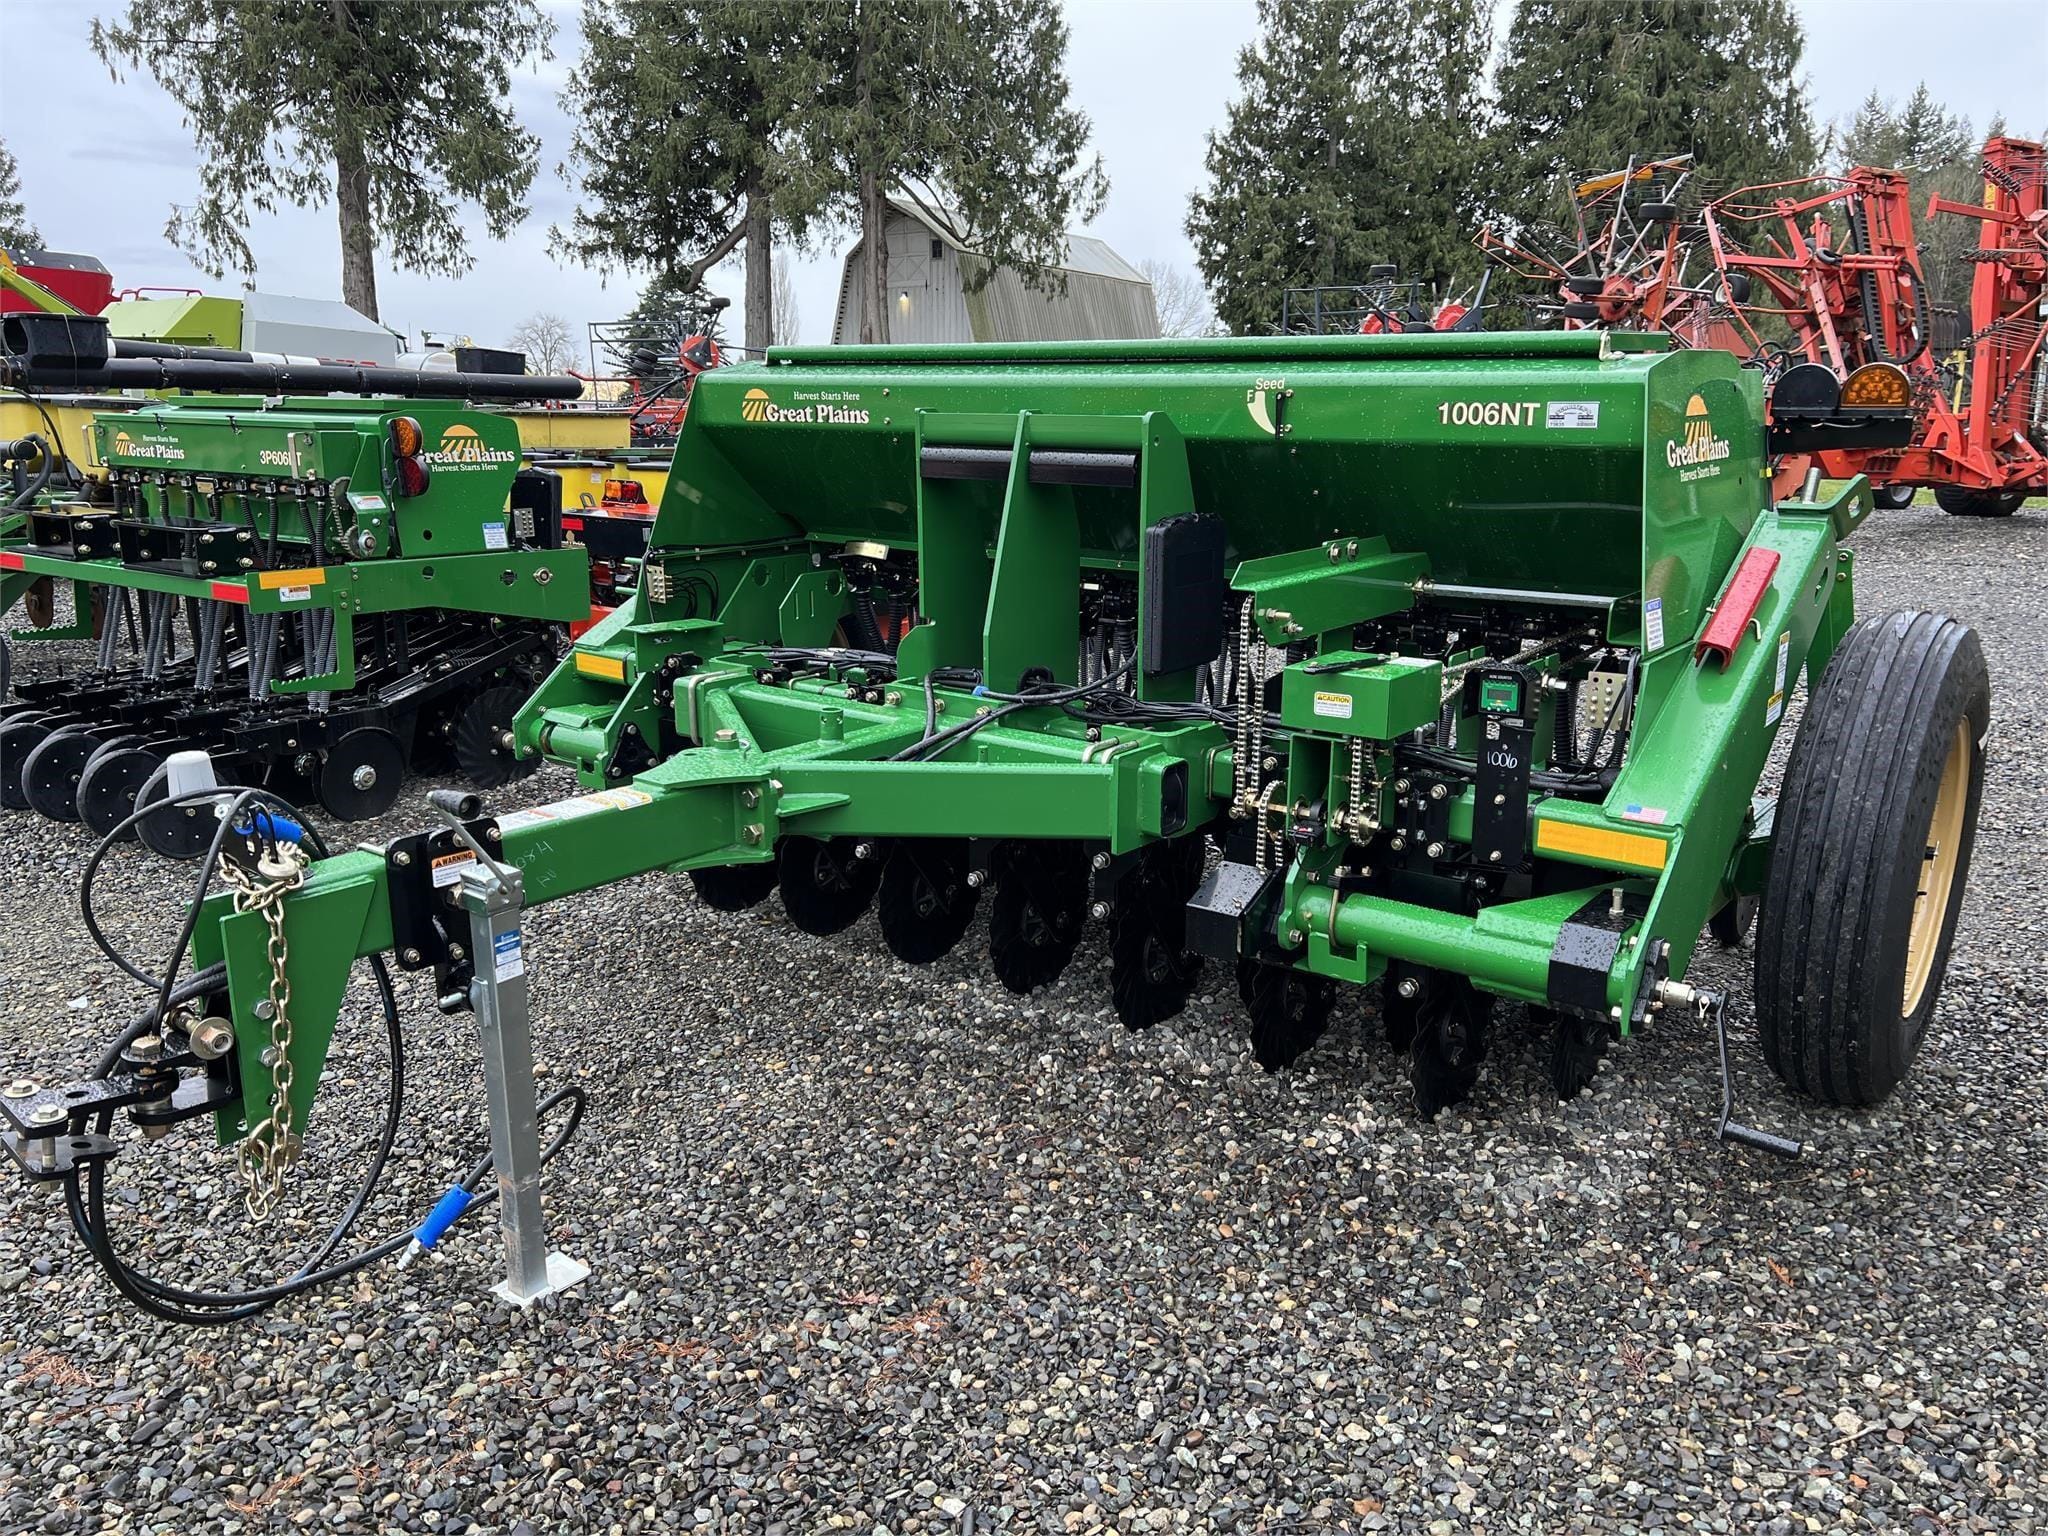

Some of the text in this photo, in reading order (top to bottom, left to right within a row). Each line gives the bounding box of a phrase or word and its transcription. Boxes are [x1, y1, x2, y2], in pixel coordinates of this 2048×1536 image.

[1255, 377, 1286, 390] Seed
[793, 391, 860, 401] Harvest Starts Here
[1246, 389, 1254, 402] F
[765, 403, 870, 424] Great Plains
[1437, 401, 1541, 426] 1006NT
[128, 443, 185, 460] Great Plains
[463, 447, 516, 462] Plains
[1666, 434, 1730, 468] Great Plains
[431, 463, 498, 472] Harvest Starts Here
[1322, 695, 1350, 703] CAUTION
[1487, 751, 1518, 769] 1006
[443, 851, 473, 866] WARNING
